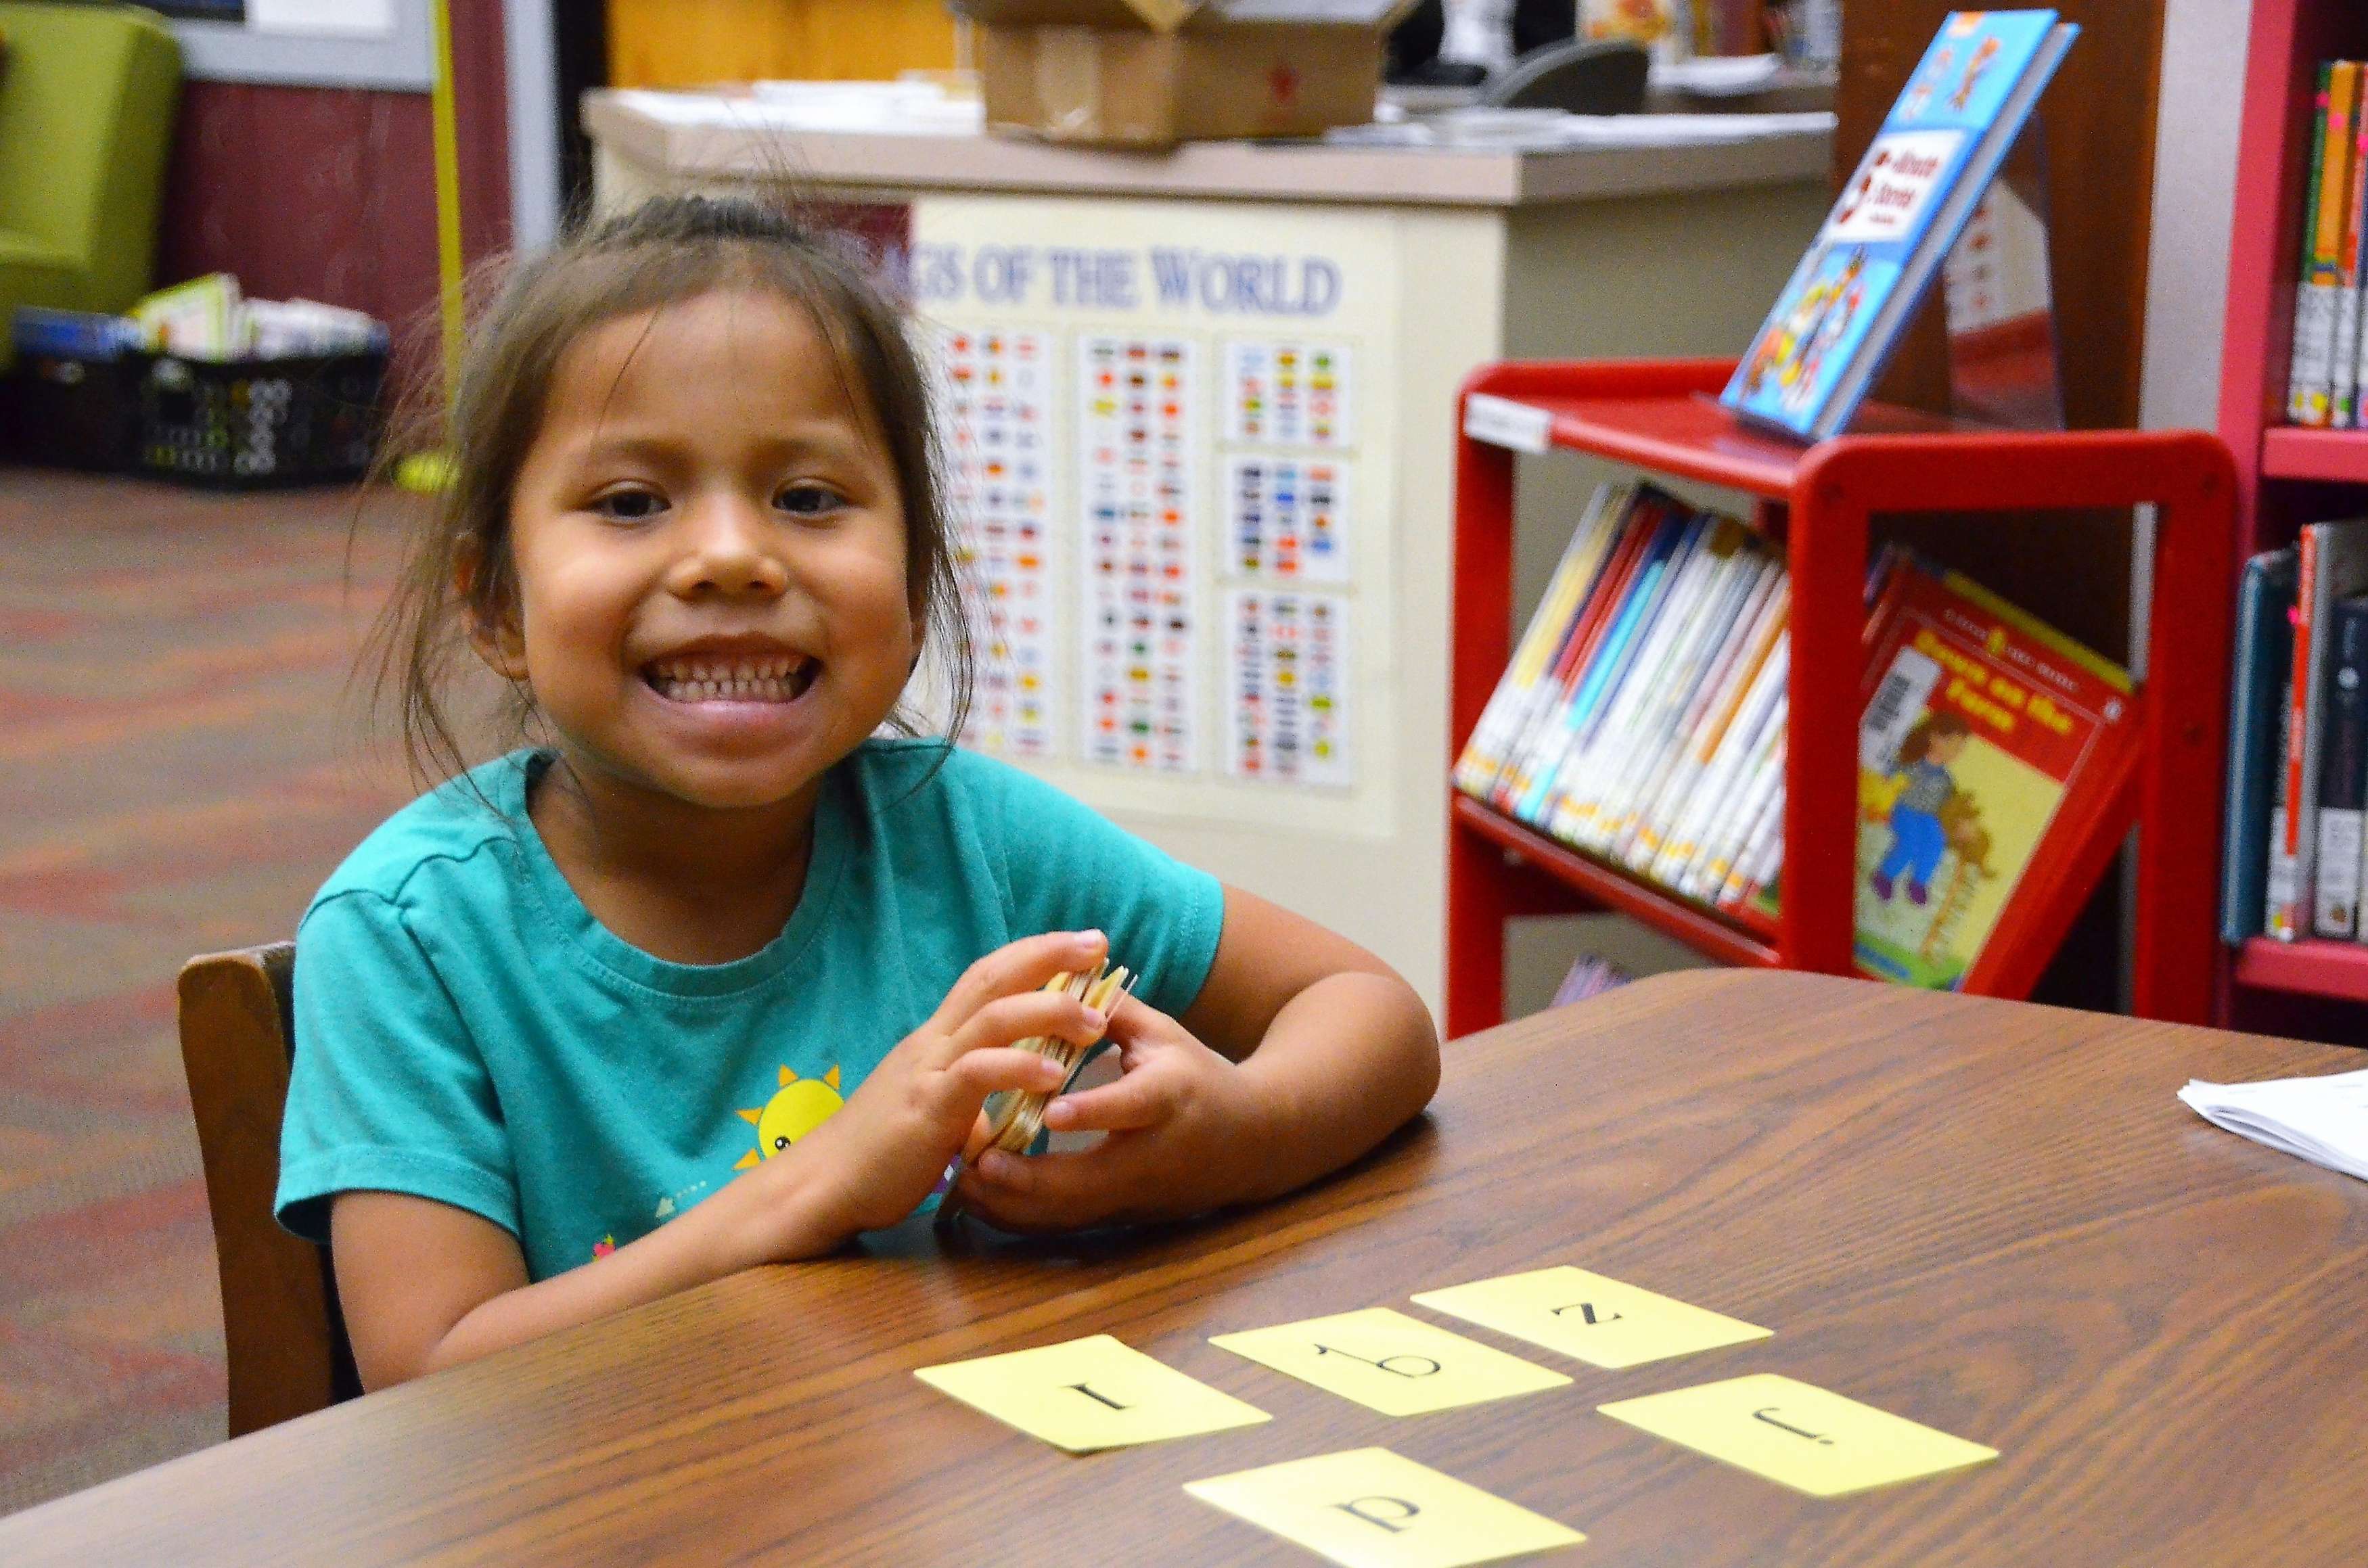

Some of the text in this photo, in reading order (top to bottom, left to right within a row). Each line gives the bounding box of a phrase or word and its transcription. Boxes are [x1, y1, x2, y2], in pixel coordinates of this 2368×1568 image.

[973, 242, 1034, 306] OF
[1047, 246, 1142, 310] THE
[1149, 245, 1344, 316] WORLD
[1751, 1406, 1834, 1445] j
